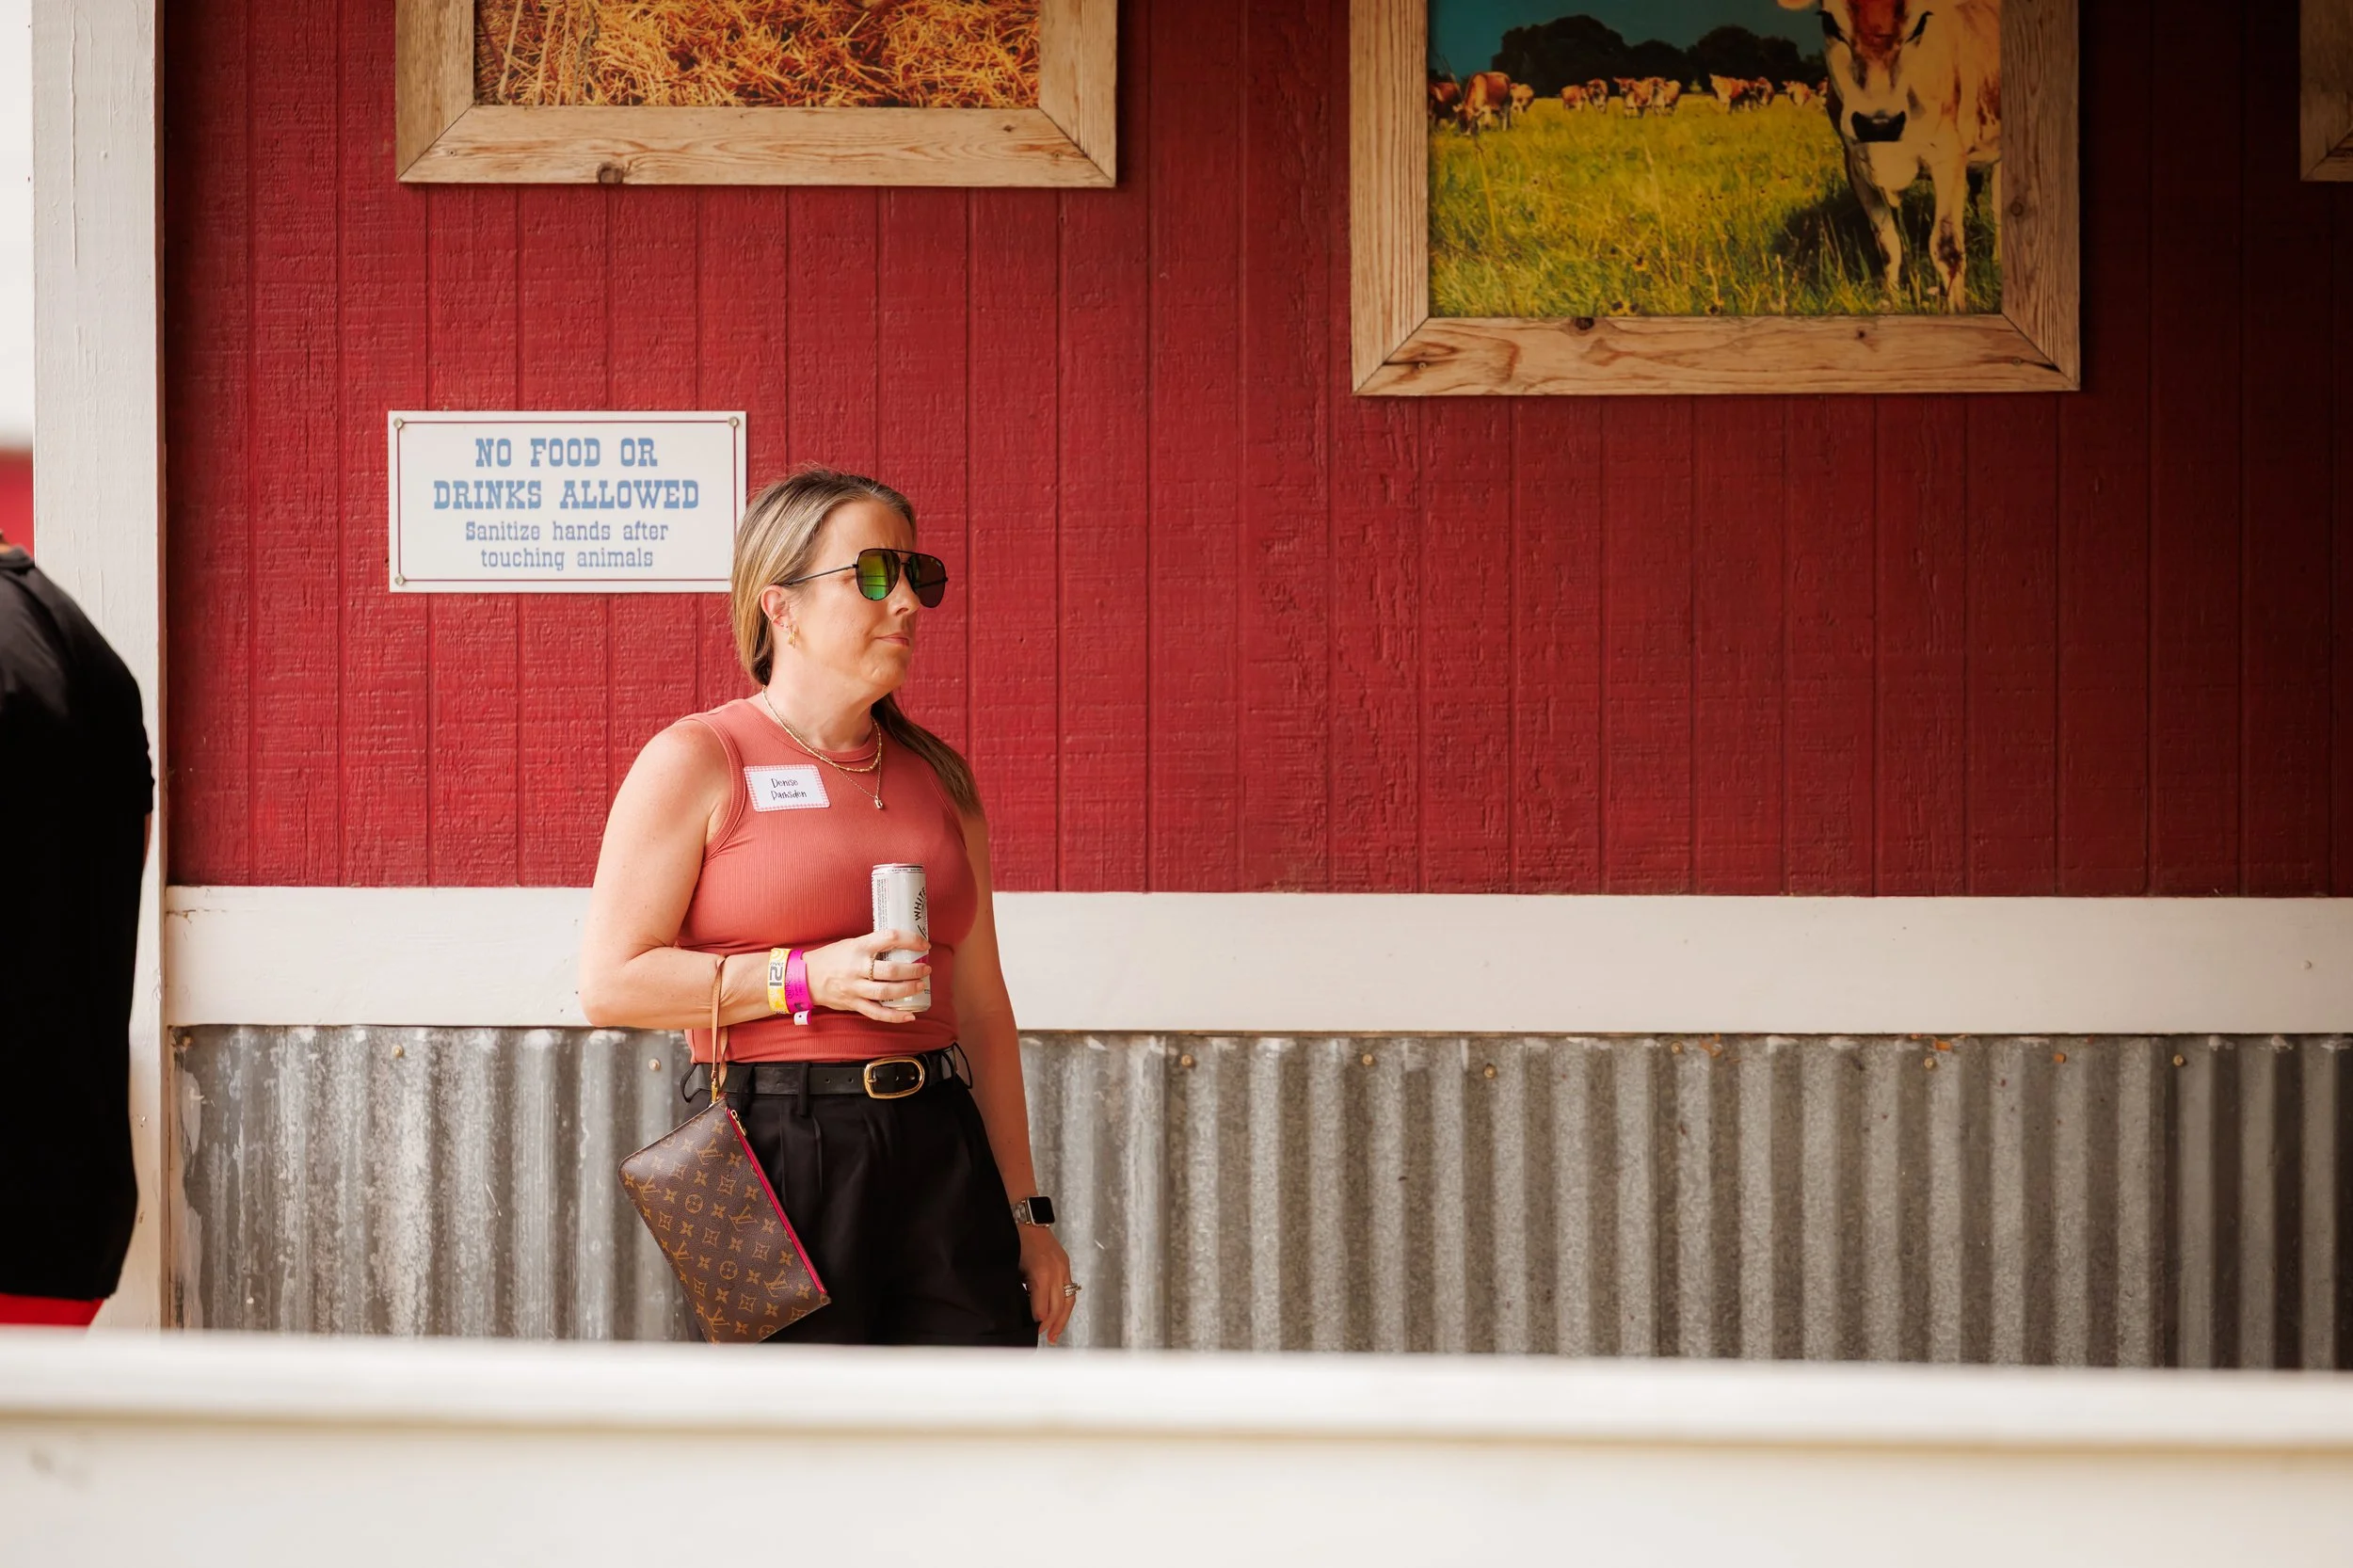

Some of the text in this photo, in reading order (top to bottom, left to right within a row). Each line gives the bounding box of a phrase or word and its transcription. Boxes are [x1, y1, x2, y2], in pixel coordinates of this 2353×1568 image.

[474, 437, 657, 468] NO FOOD OR
[433, 480, 699, 510] DRINKS ALLOWED
[466, 520, 669, 541] Sanitize hands after
[481, 548, 653, 571] touching animals
[771, 778, 799, 789] Denise
